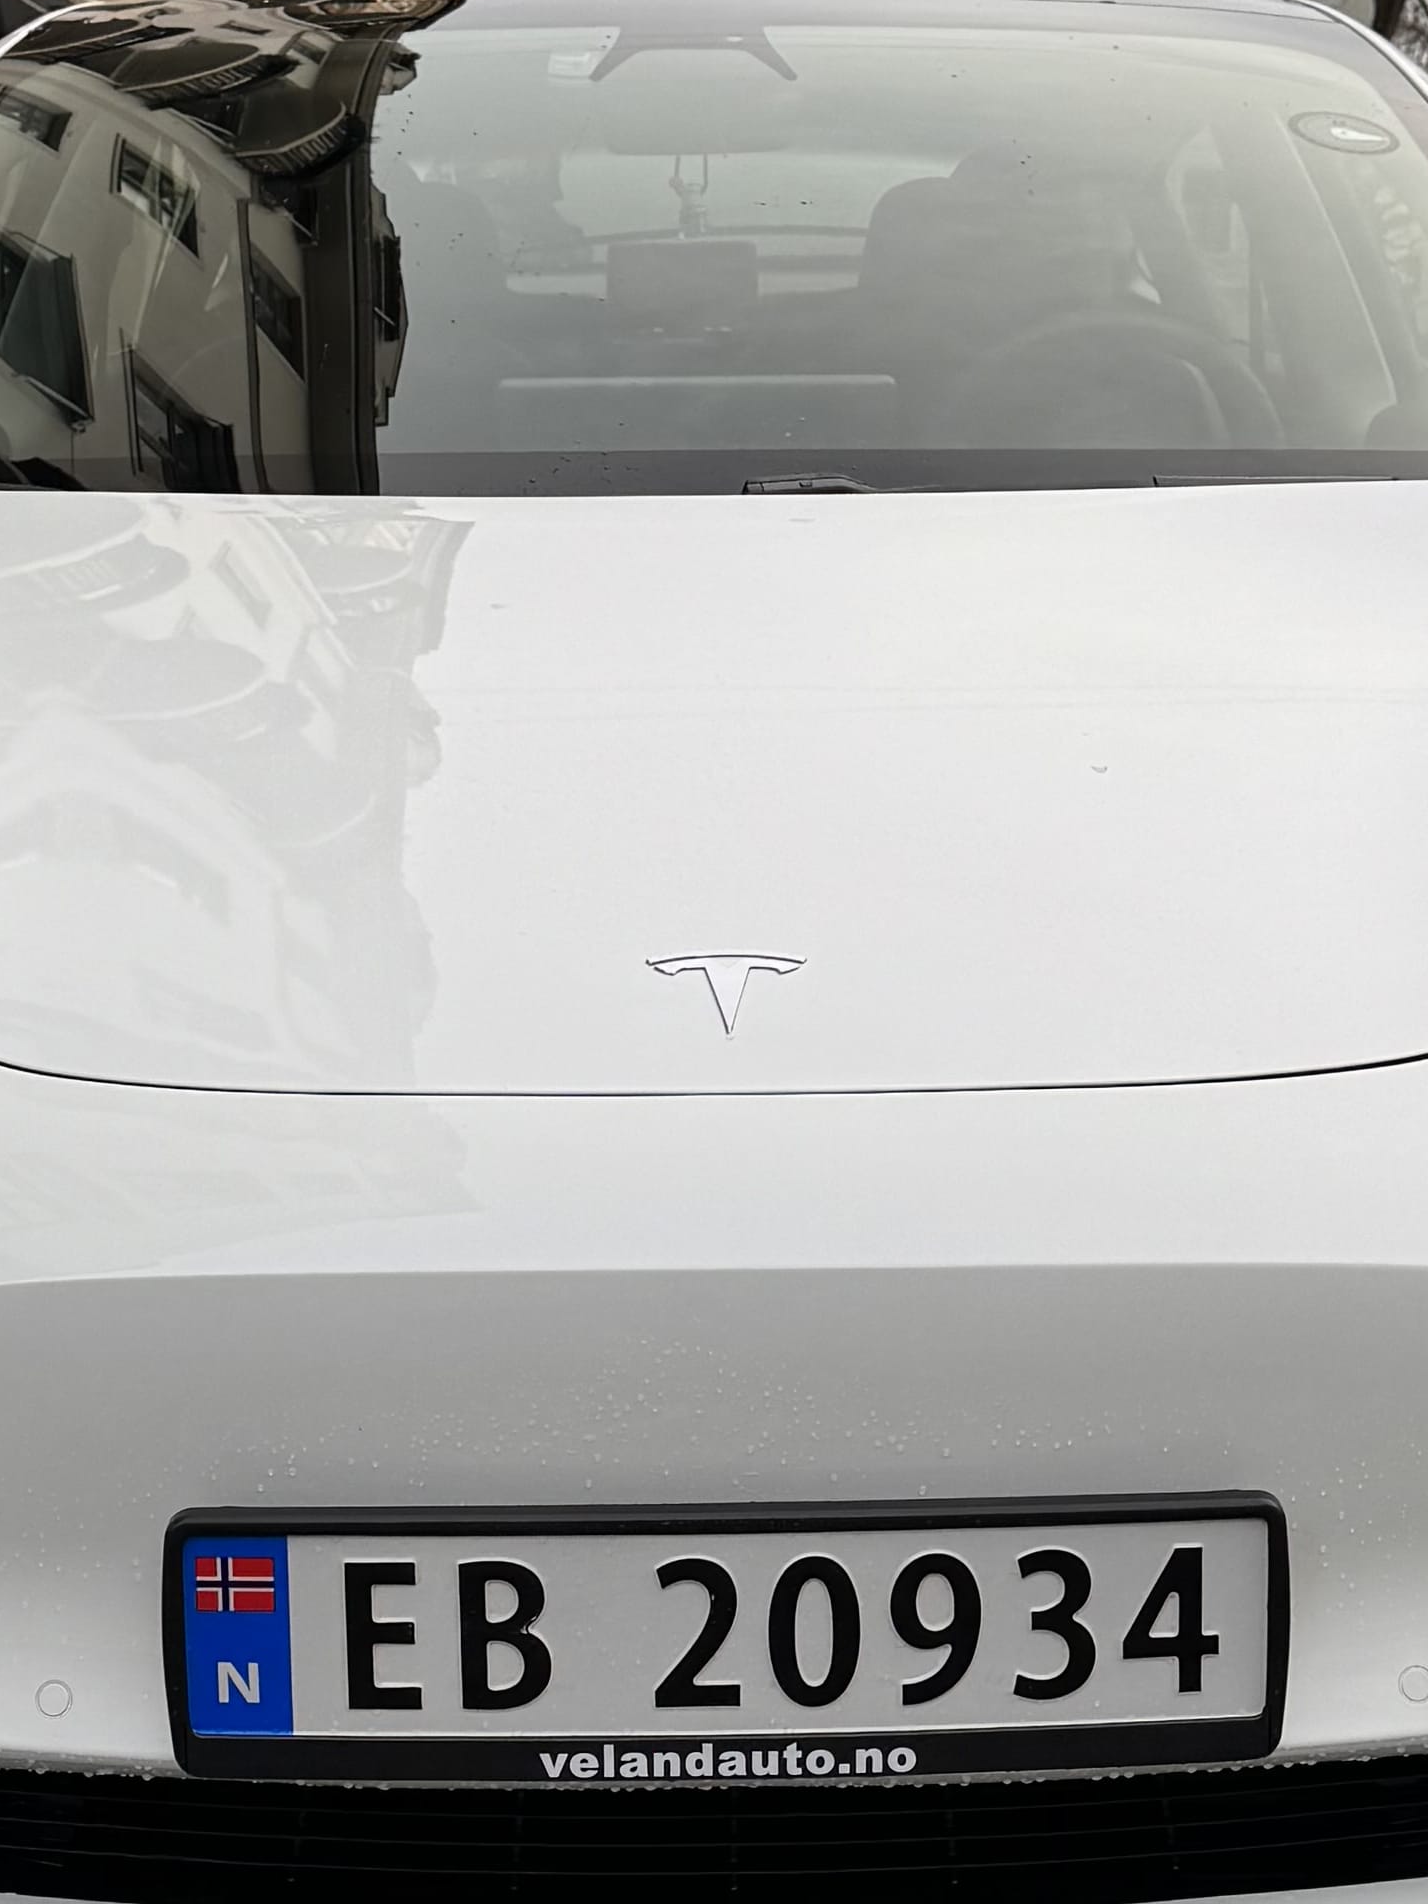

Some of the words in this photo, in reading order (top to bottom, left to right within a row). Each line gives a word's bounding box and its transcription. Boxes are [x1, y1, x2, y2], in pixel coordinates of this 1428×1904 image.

[341, 1559, 553, 1711] EB
[653, 1545, 1221, 1708] 20934
[217, 1661, 261, 1704] N
[538, 1742, 918, 1779] velandauto.no
